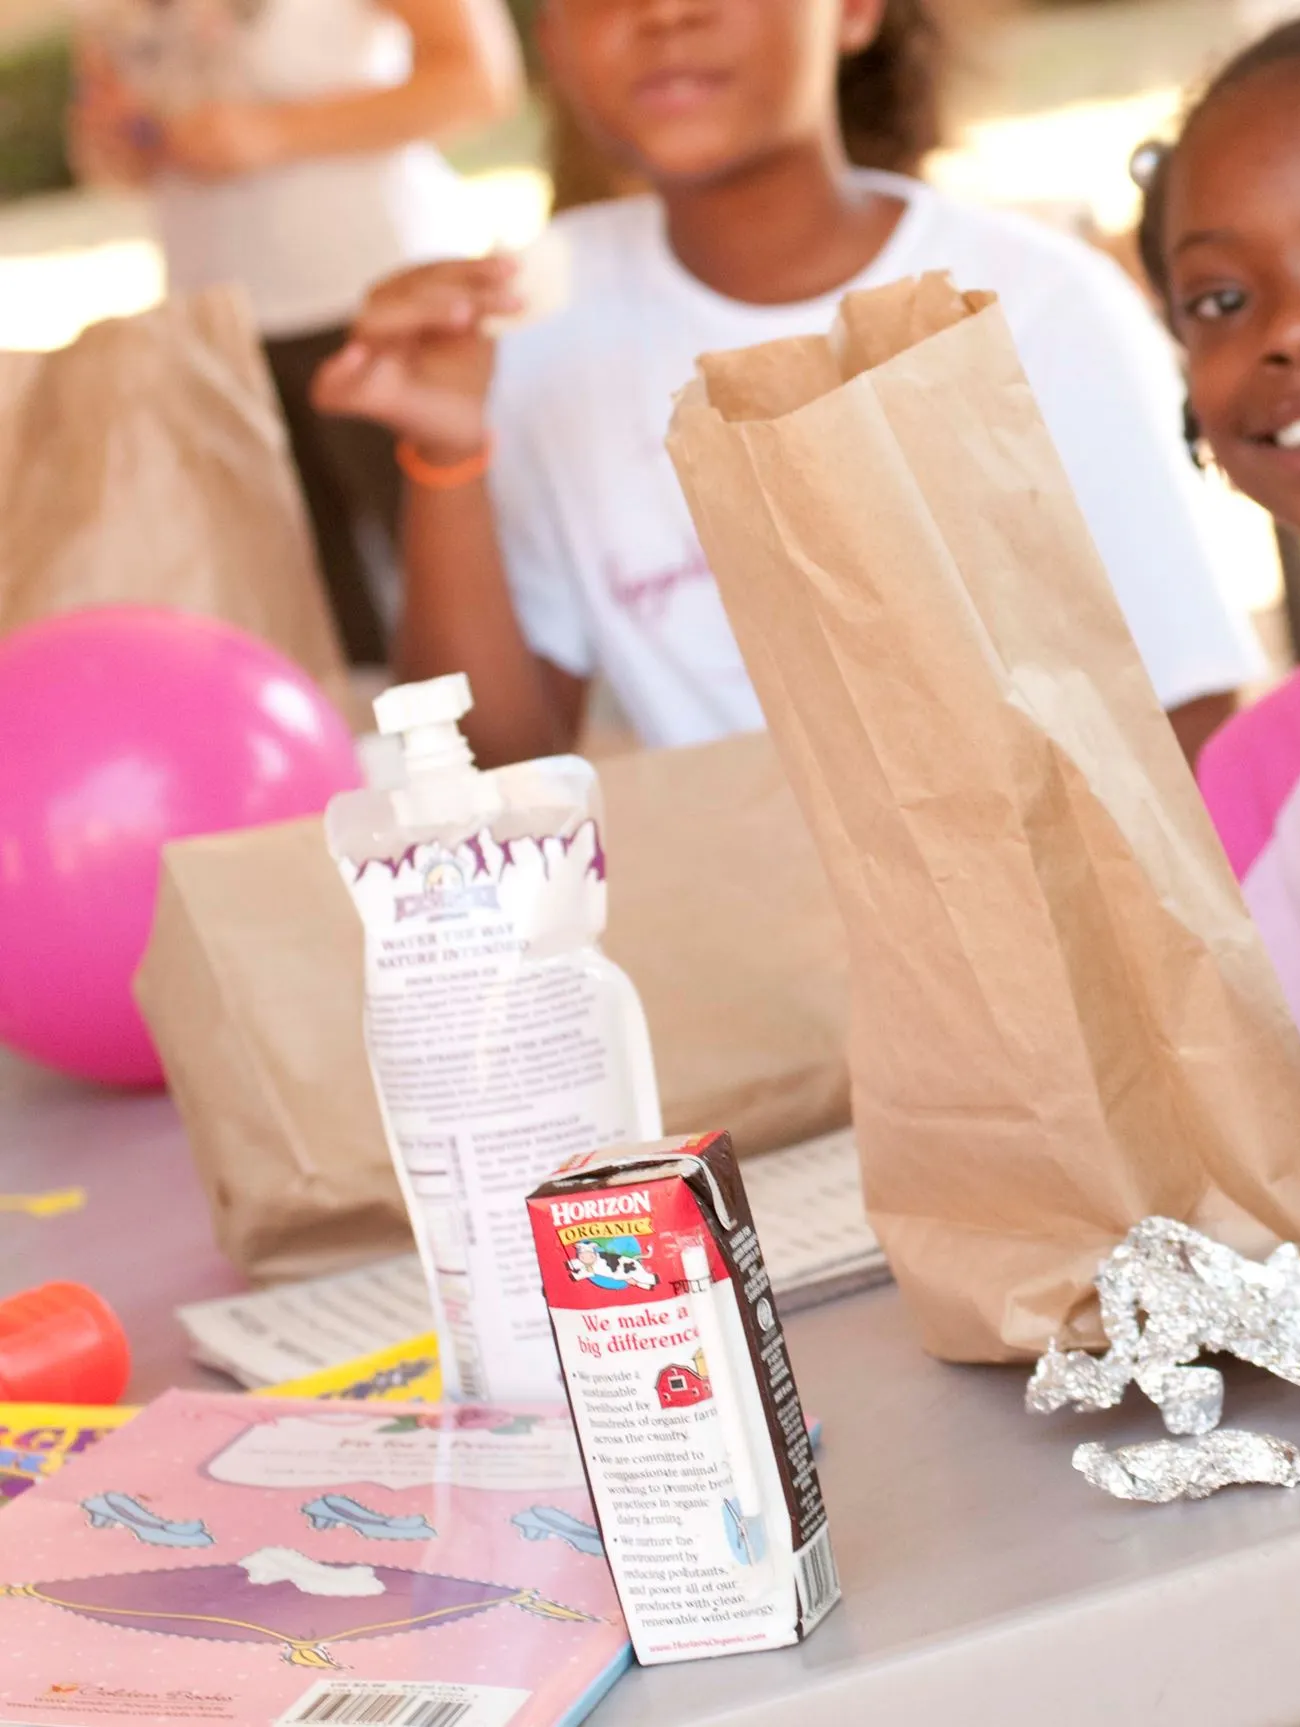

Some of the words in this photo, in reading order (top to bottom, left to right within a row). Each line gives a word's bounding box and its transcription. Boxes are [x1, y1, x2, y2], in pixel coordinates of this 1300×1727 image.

[550, 1190, 652, 1226] HORIZON
[564, 1221, 645, 1241] ORGANIC
[582, 1314, 610, 1333] We
[618, 1309, 669, 1329] make
[677, 1306, 689, 1318] a
[577, 1335, 601, 1358] big
[592, 1371, 632, 1385] provide
[582, 1386, 638, 1398] sustainable
[638, 1417, 650, 1428] of
[651, 1415, 691, 1429] organic
[593, 1434, 623, 1445] across
[625, 1432, 645, 1444] the
[598, 1453, 614, 1464] We
[614, 1455, 630, 1465] are
[632, 1451, 690, 1464] committed
[692, 1450, 705, 1461] to
[602, 1467, 680, 1482] compassionate
[681, 1462, 718, 1477] animal
[607, 1484, 647, 1496] working
[648, 1482, 662, 1494] to
[663, 1483, 707, 1495] promote
[659, 1498, 670, 1508] in
[675, 1534, 694, 1546] the
[685, 1550, 699, 1563] by
[648, 1584, 683, 1597] power
[701, 1581, 715, 1592] of
[716, 1579, 738, 1590] our
[634, 1599, 683, 1613] products
[684, 1596, 711, 1610] with
[641, 1614, 699, 1627] renewable
[700, 1611, 732, 1624] wind
